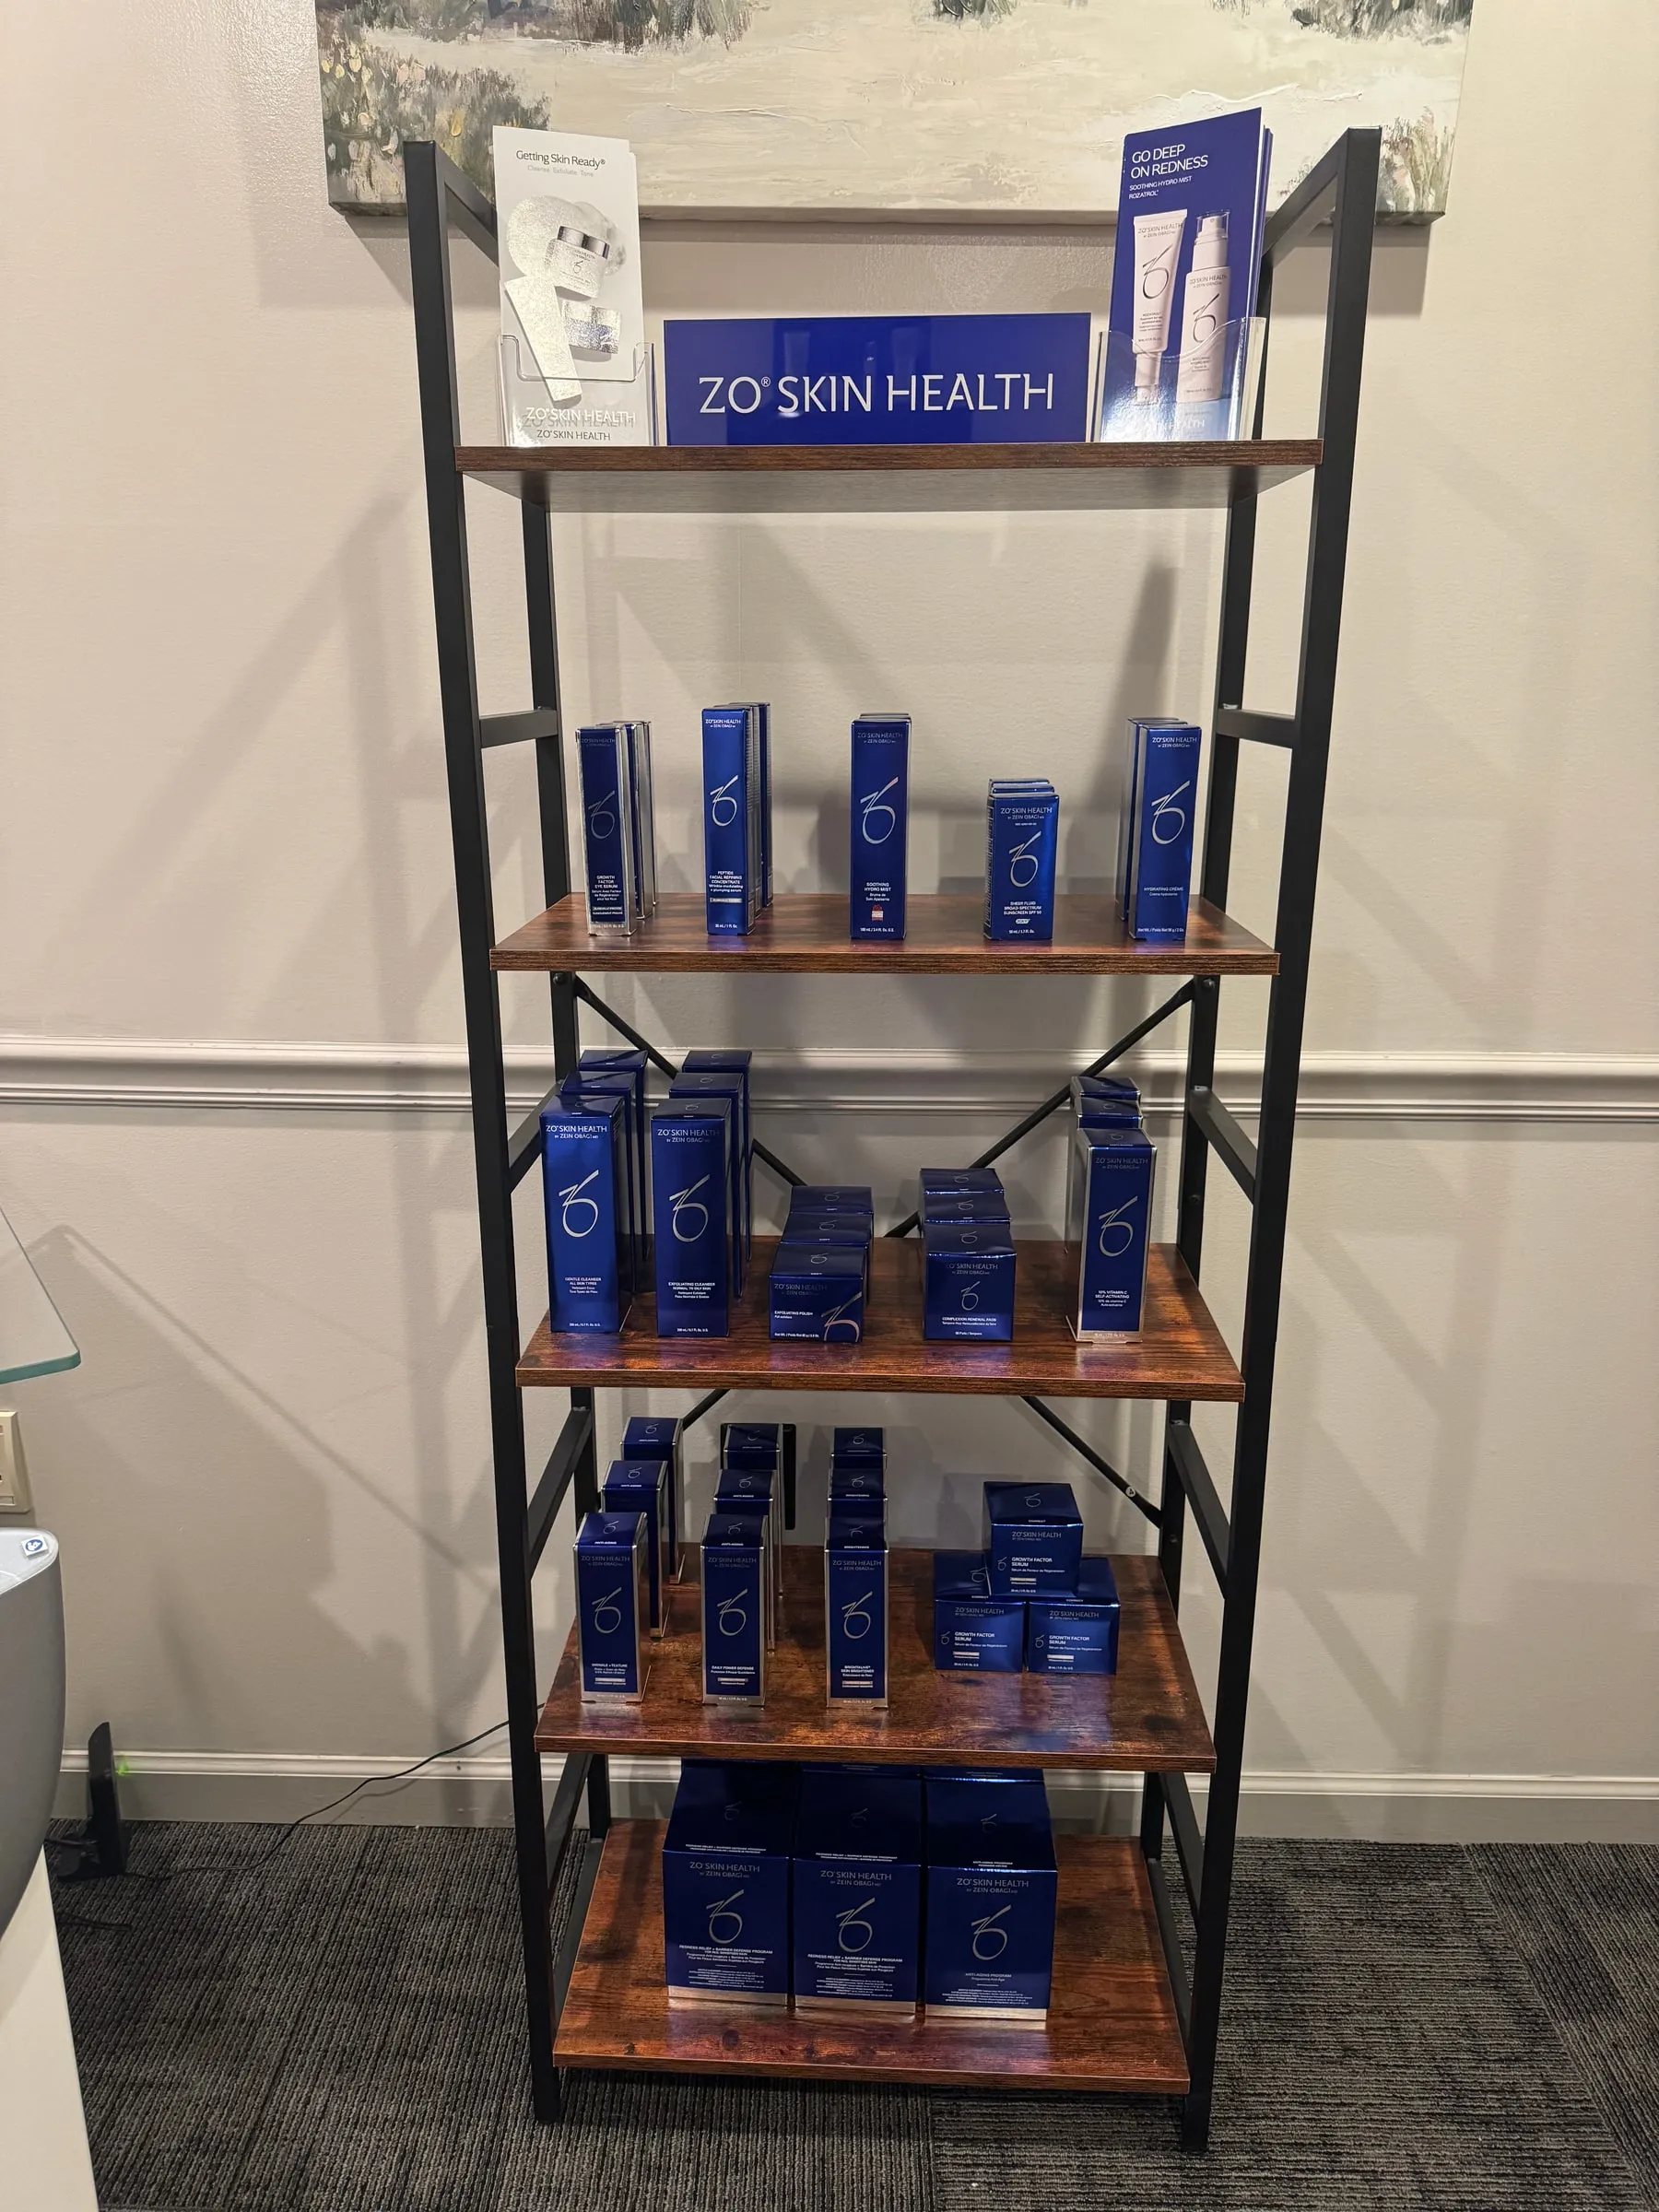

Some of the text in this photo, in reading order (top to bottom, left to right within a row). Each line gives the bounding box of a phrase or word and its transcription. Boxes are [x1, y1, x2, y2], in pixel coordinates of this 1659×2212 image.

[516, 150, 550, 166] Getting
[551, 153, 571, 165] Skin
[1132, 144, 1186, 165] GO DEEP
[1131, 155, 1209, 179] ON REDNESS
[1129, 175, 1193, 191] SOOTHING HYDRO MIST
[777, 374, 873, 414] SKIN
[887, 372, 1054, 412] HEALTH
[550, 408, 582, 422] SKIN
[583, 410, 636, 424] HEALTH
[554, 430, 574, 440] SKIN
[576, 431, 612, 441] HEALTH
[559, 1124, 577, 1133] SKIN
[705, 1863, 725, 1871] SKIN
[726, 1864, 760, 1873] HEALTH
[836, 1871, 856, 1879] SKIN
[857, 1872, 892, 1881] HEALTH
[972, 1878, 993, 1887] SKIN
[994, 1879, 1030, 1888] HEALTH
